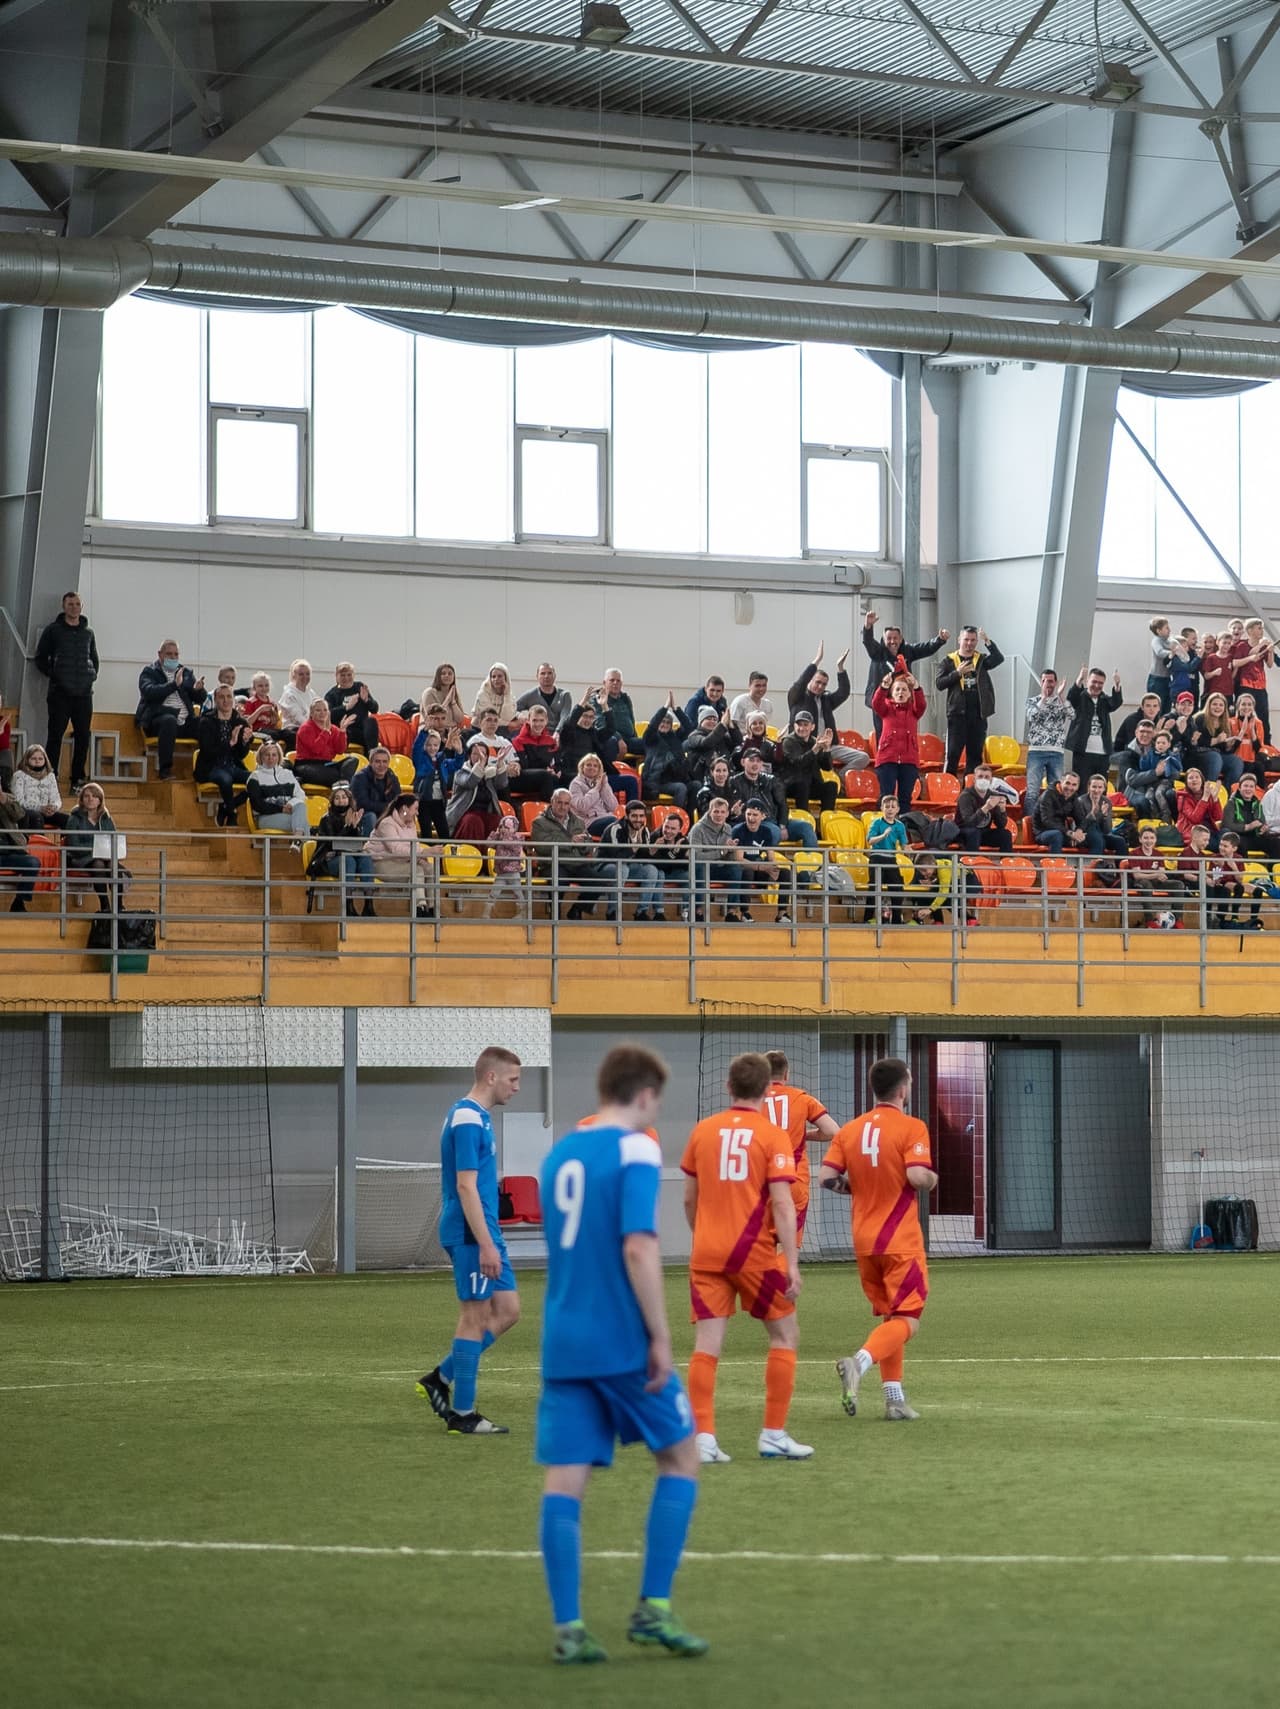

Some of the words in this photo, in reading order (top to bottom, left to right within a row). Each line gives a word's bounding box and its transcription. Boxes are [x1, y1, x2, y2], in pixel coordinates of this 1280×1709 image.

[764, 1095, 788, 1130] 17
[719, 1128, 753, 1181] 15
[861, 1122, 880, 1167] 4
[555, 1159, 585, 1249] 9
[470, 1272, 488, 1294] 17
